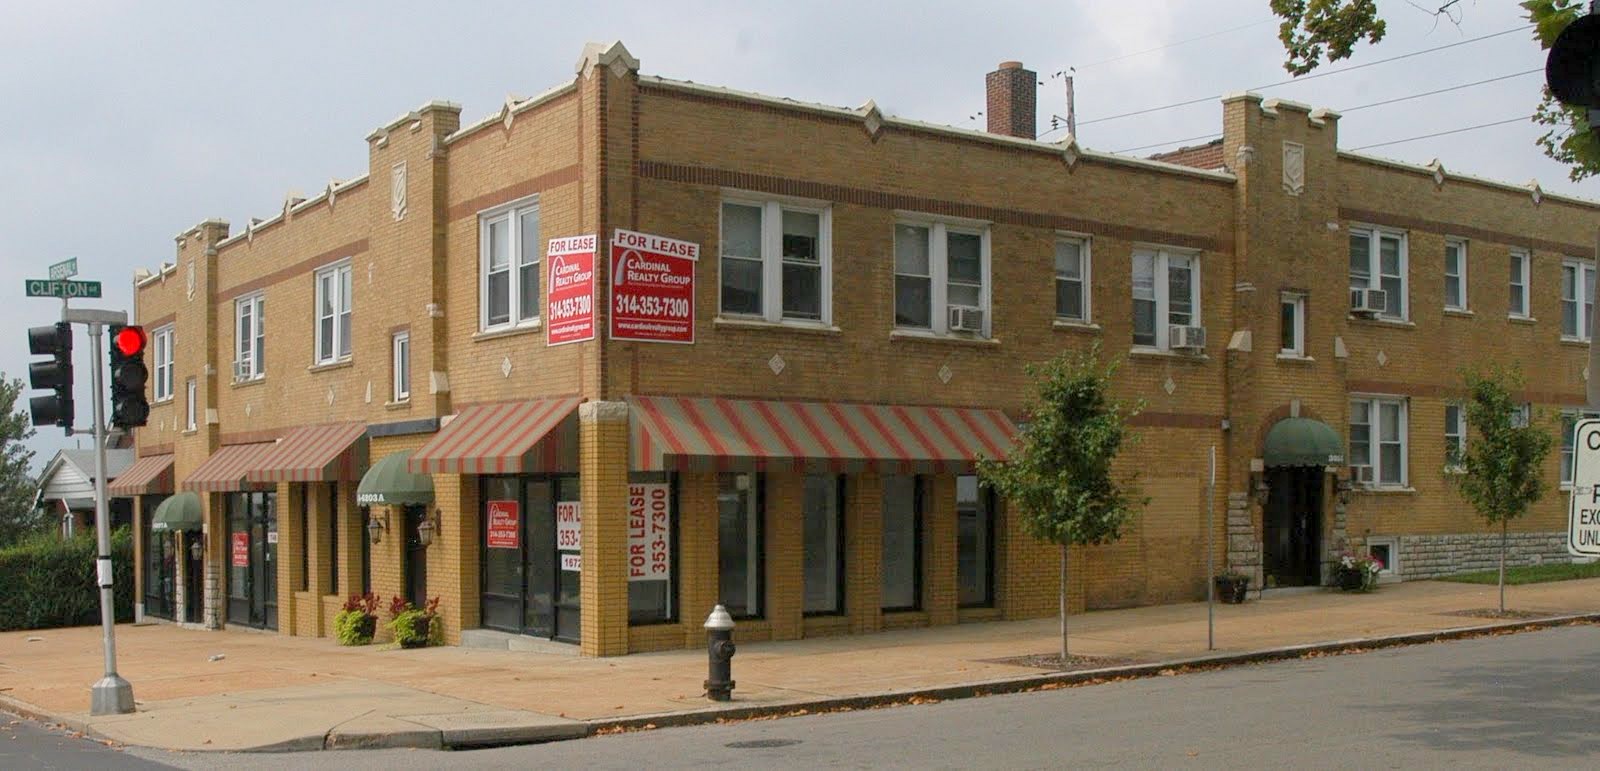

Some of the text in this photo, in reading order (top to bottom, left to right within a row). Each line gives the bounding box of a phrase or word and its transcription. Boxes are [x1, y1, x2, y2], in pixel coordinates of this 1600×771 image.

[550, 238, 594, 253] FOR LEASE
[618, 232, 696, 258] FOR LEASE
[555, 262, 581, 276] CARDINAL
[627, 258, 671, 273] CARDINAL
[555, 276, 574, 288] REALTY
[573, 271, 592, 283] GROUP
[627, 270, 659, 283] REALTY
[660, 273, 691, 286] GROUP
[30, 281, 88, 296] CLIFTON
[550, 294, 591, 321] 314-353-7300
[616, 294, 689, 318] 314-353-7300
[558, 505, 574, 522] FOR
[630, 486, 646, 577] FOR LEASE
[651, 488, 666, 573] 353-7300
[1579, 530, 1600, 546] UNL
